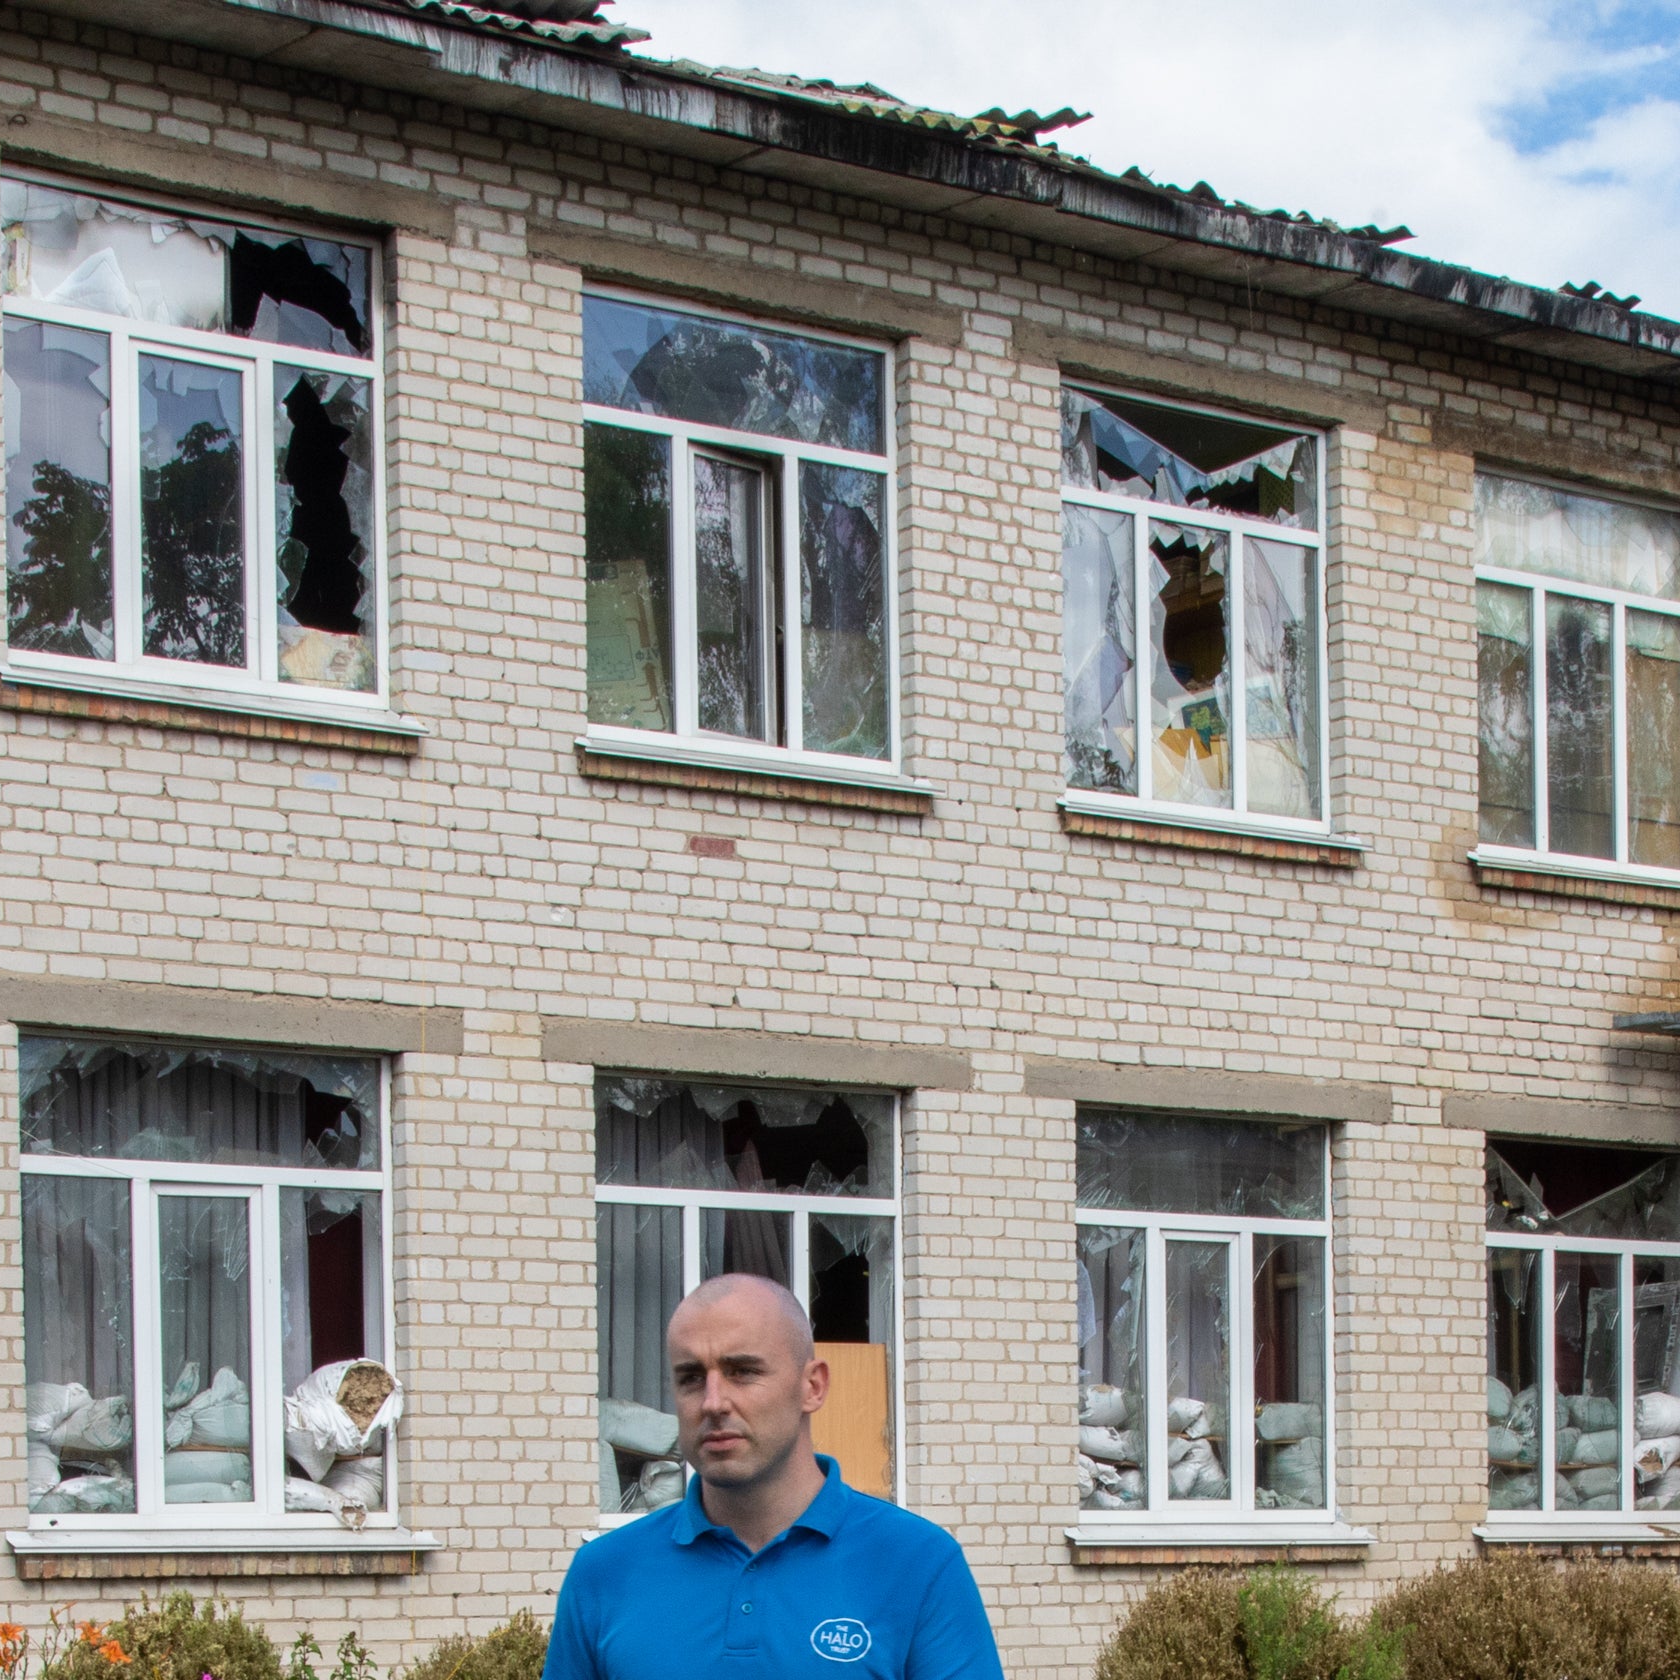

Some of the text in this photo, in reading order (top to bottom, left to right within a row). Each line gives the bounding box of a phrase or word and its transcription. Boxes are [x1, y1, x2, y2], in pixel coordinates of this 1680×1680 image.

[835, 1625, 848, 1633] THE
[820, 1631, 863, 1649] HALO
[830, 1645, 851, 1654] TRUST
